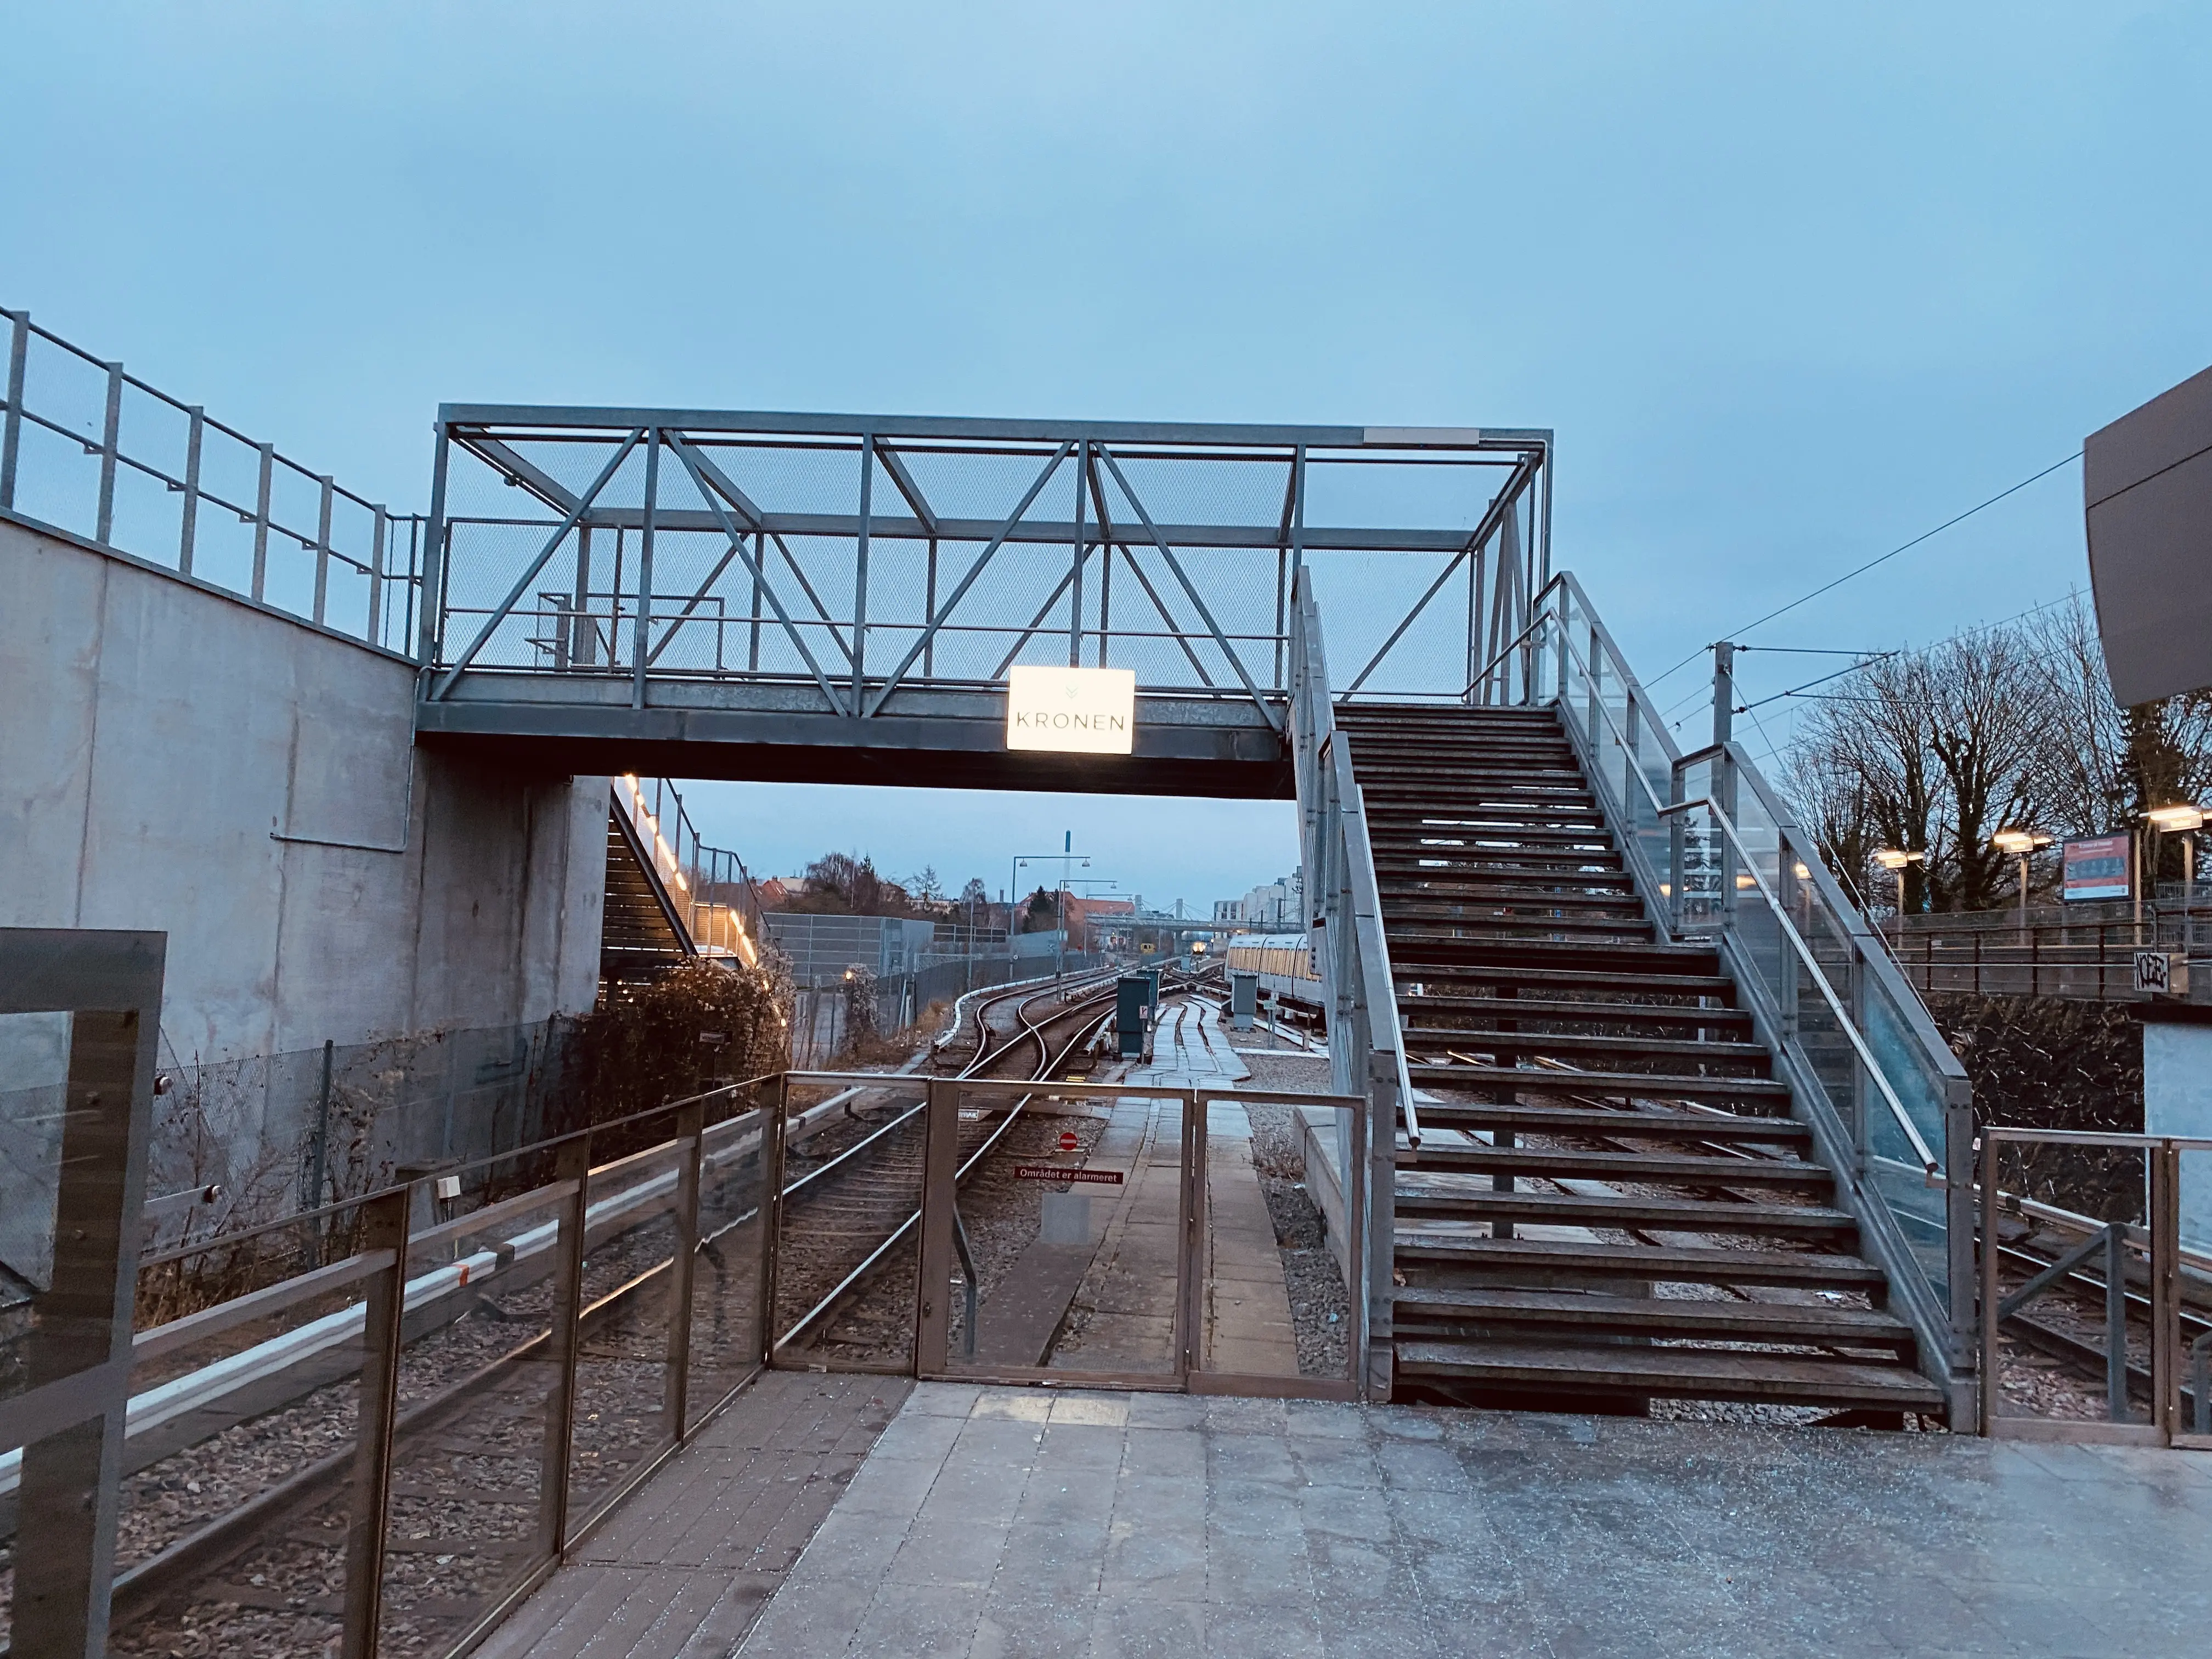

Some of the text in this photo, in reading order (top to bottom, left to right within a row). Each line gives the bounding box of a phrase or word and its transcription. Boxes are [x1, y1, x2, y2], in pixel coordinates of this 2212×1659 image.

[1017, 712, 1124, 731] KRONEN
[1020, 1169, 1060, 1178] Området
[1074, 1171, 1117, 1182] alarmeret
